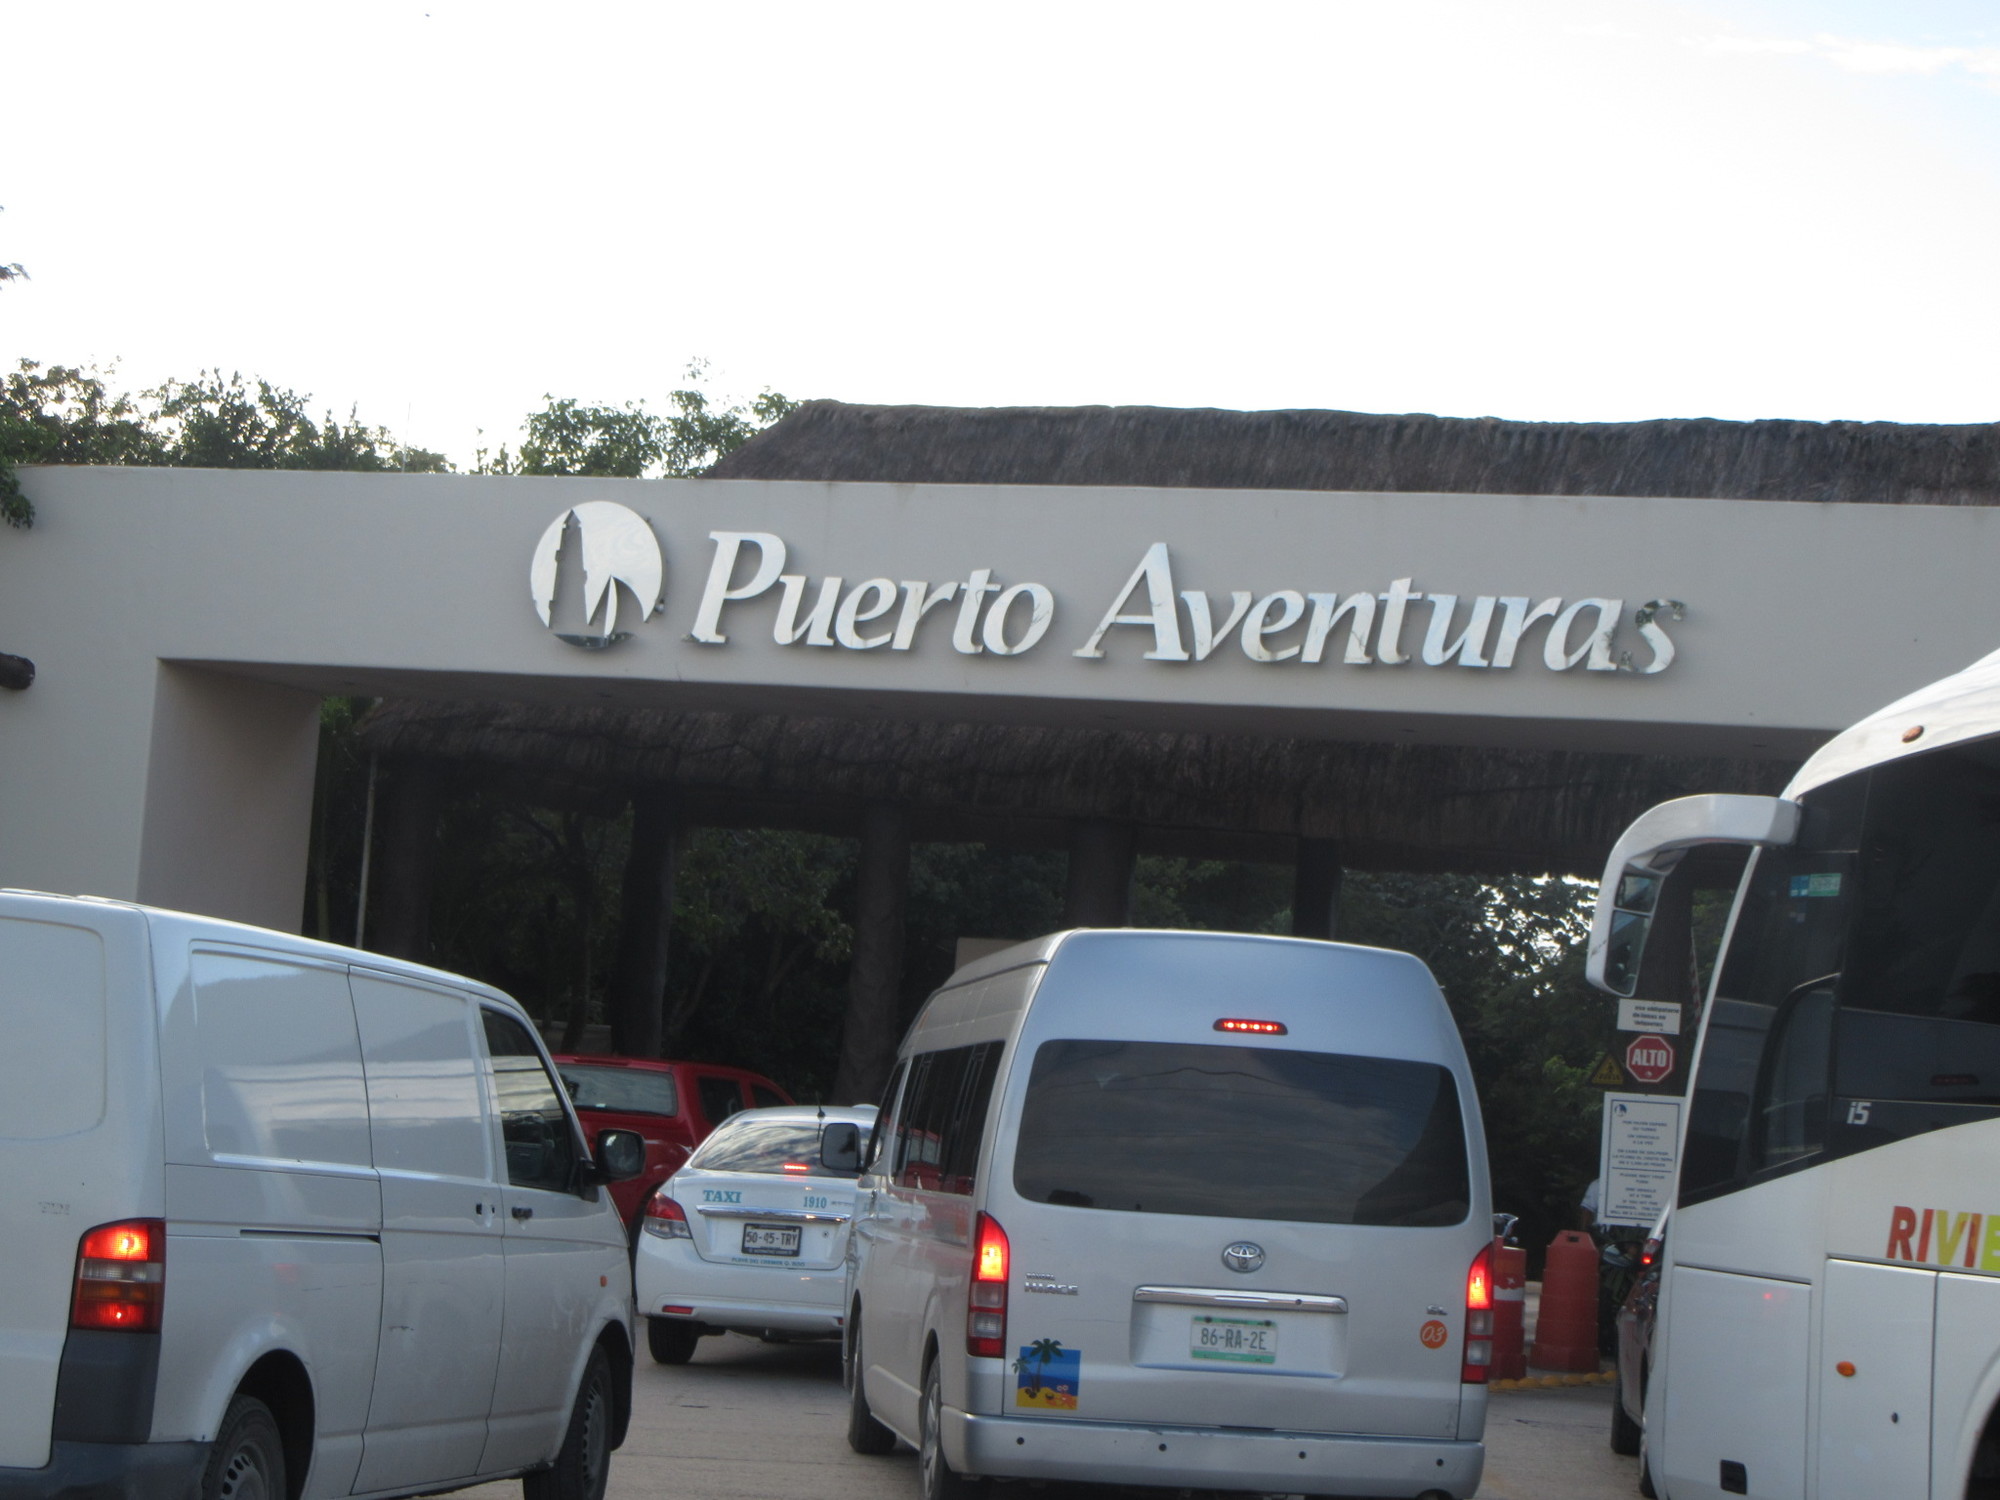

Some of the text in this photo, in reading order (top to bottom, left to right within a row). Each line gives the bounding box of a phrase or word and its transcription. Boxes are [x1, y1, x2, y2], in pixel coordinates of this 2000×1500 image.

[688, 530, 1687, 674] Puerto Aventuras
[1631, 1048, 1667, 1067] ALTO
[1846, 1101, 1872, 1125] i5
[703, 1190, 742, 1204] TAXI
[803, 1196, 827, 1208] 1910
[1201, 1327, 1267, 1350] 86-RA-2E
[1422, 1326, 1445, 1343] 03
